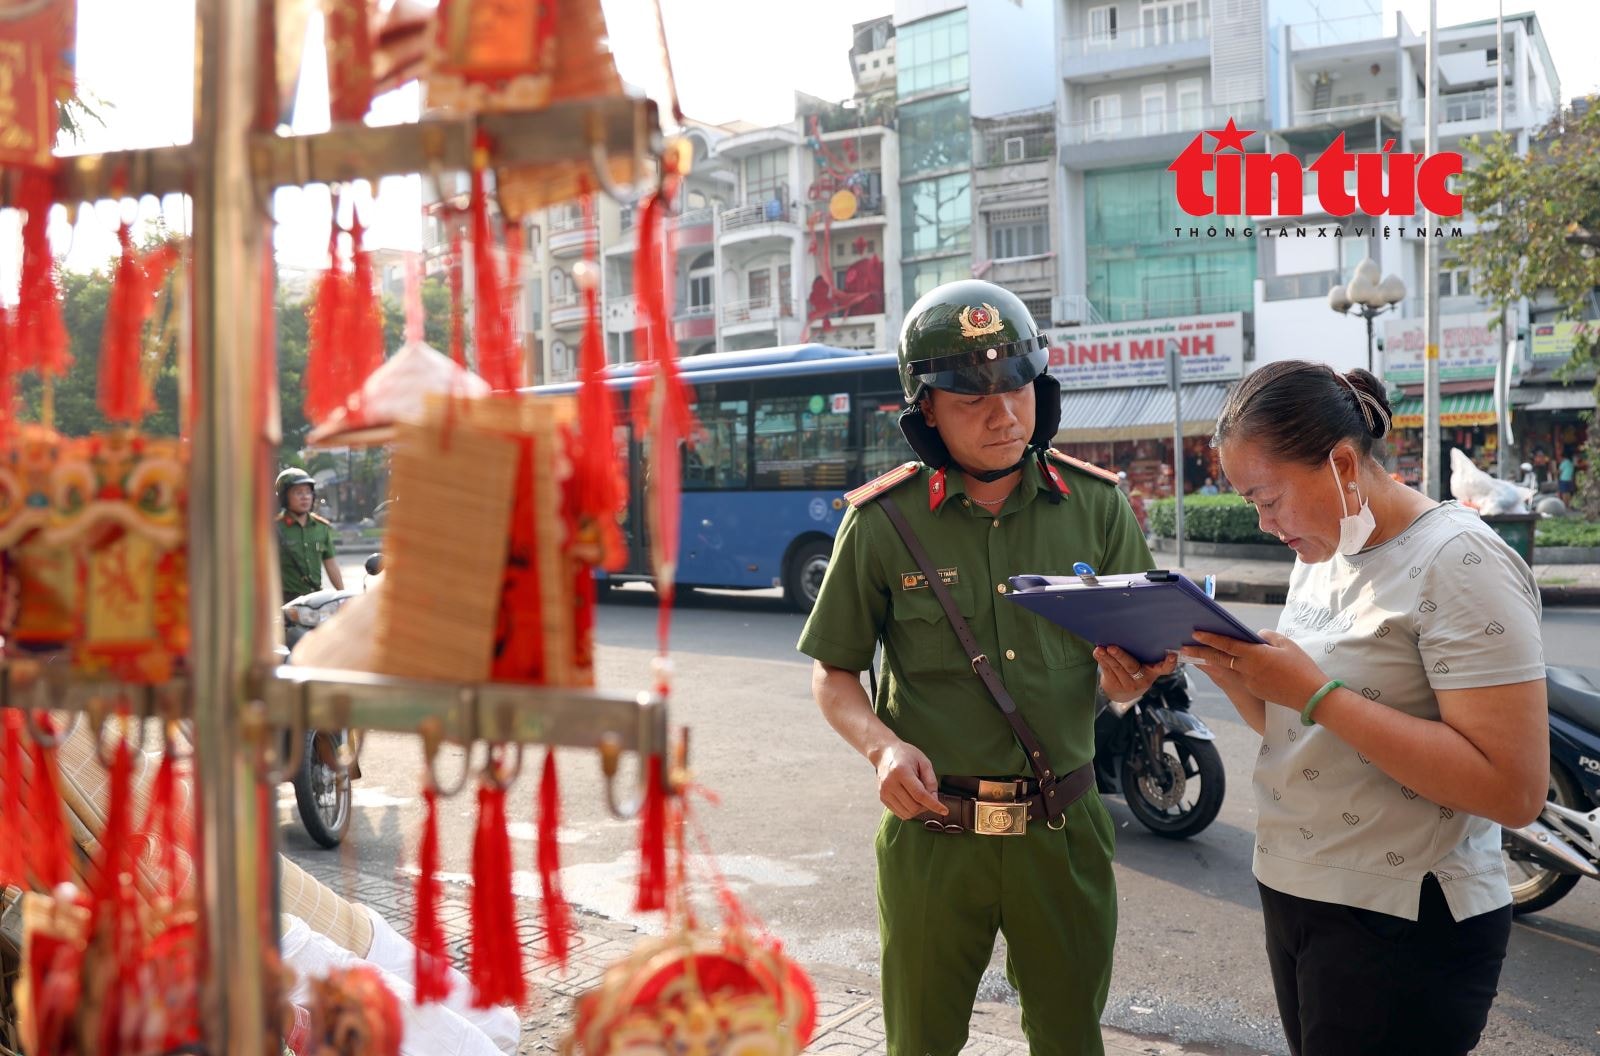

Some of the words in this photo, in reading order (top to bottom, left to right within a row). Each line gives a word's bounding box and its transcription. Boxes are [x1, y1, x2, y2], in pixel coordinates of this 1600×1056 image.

[1048, 342, 1121, 367] BÌNH
[1129, 335, 1215, 360] MINH
[1579, 755, 1600, 771] PO
